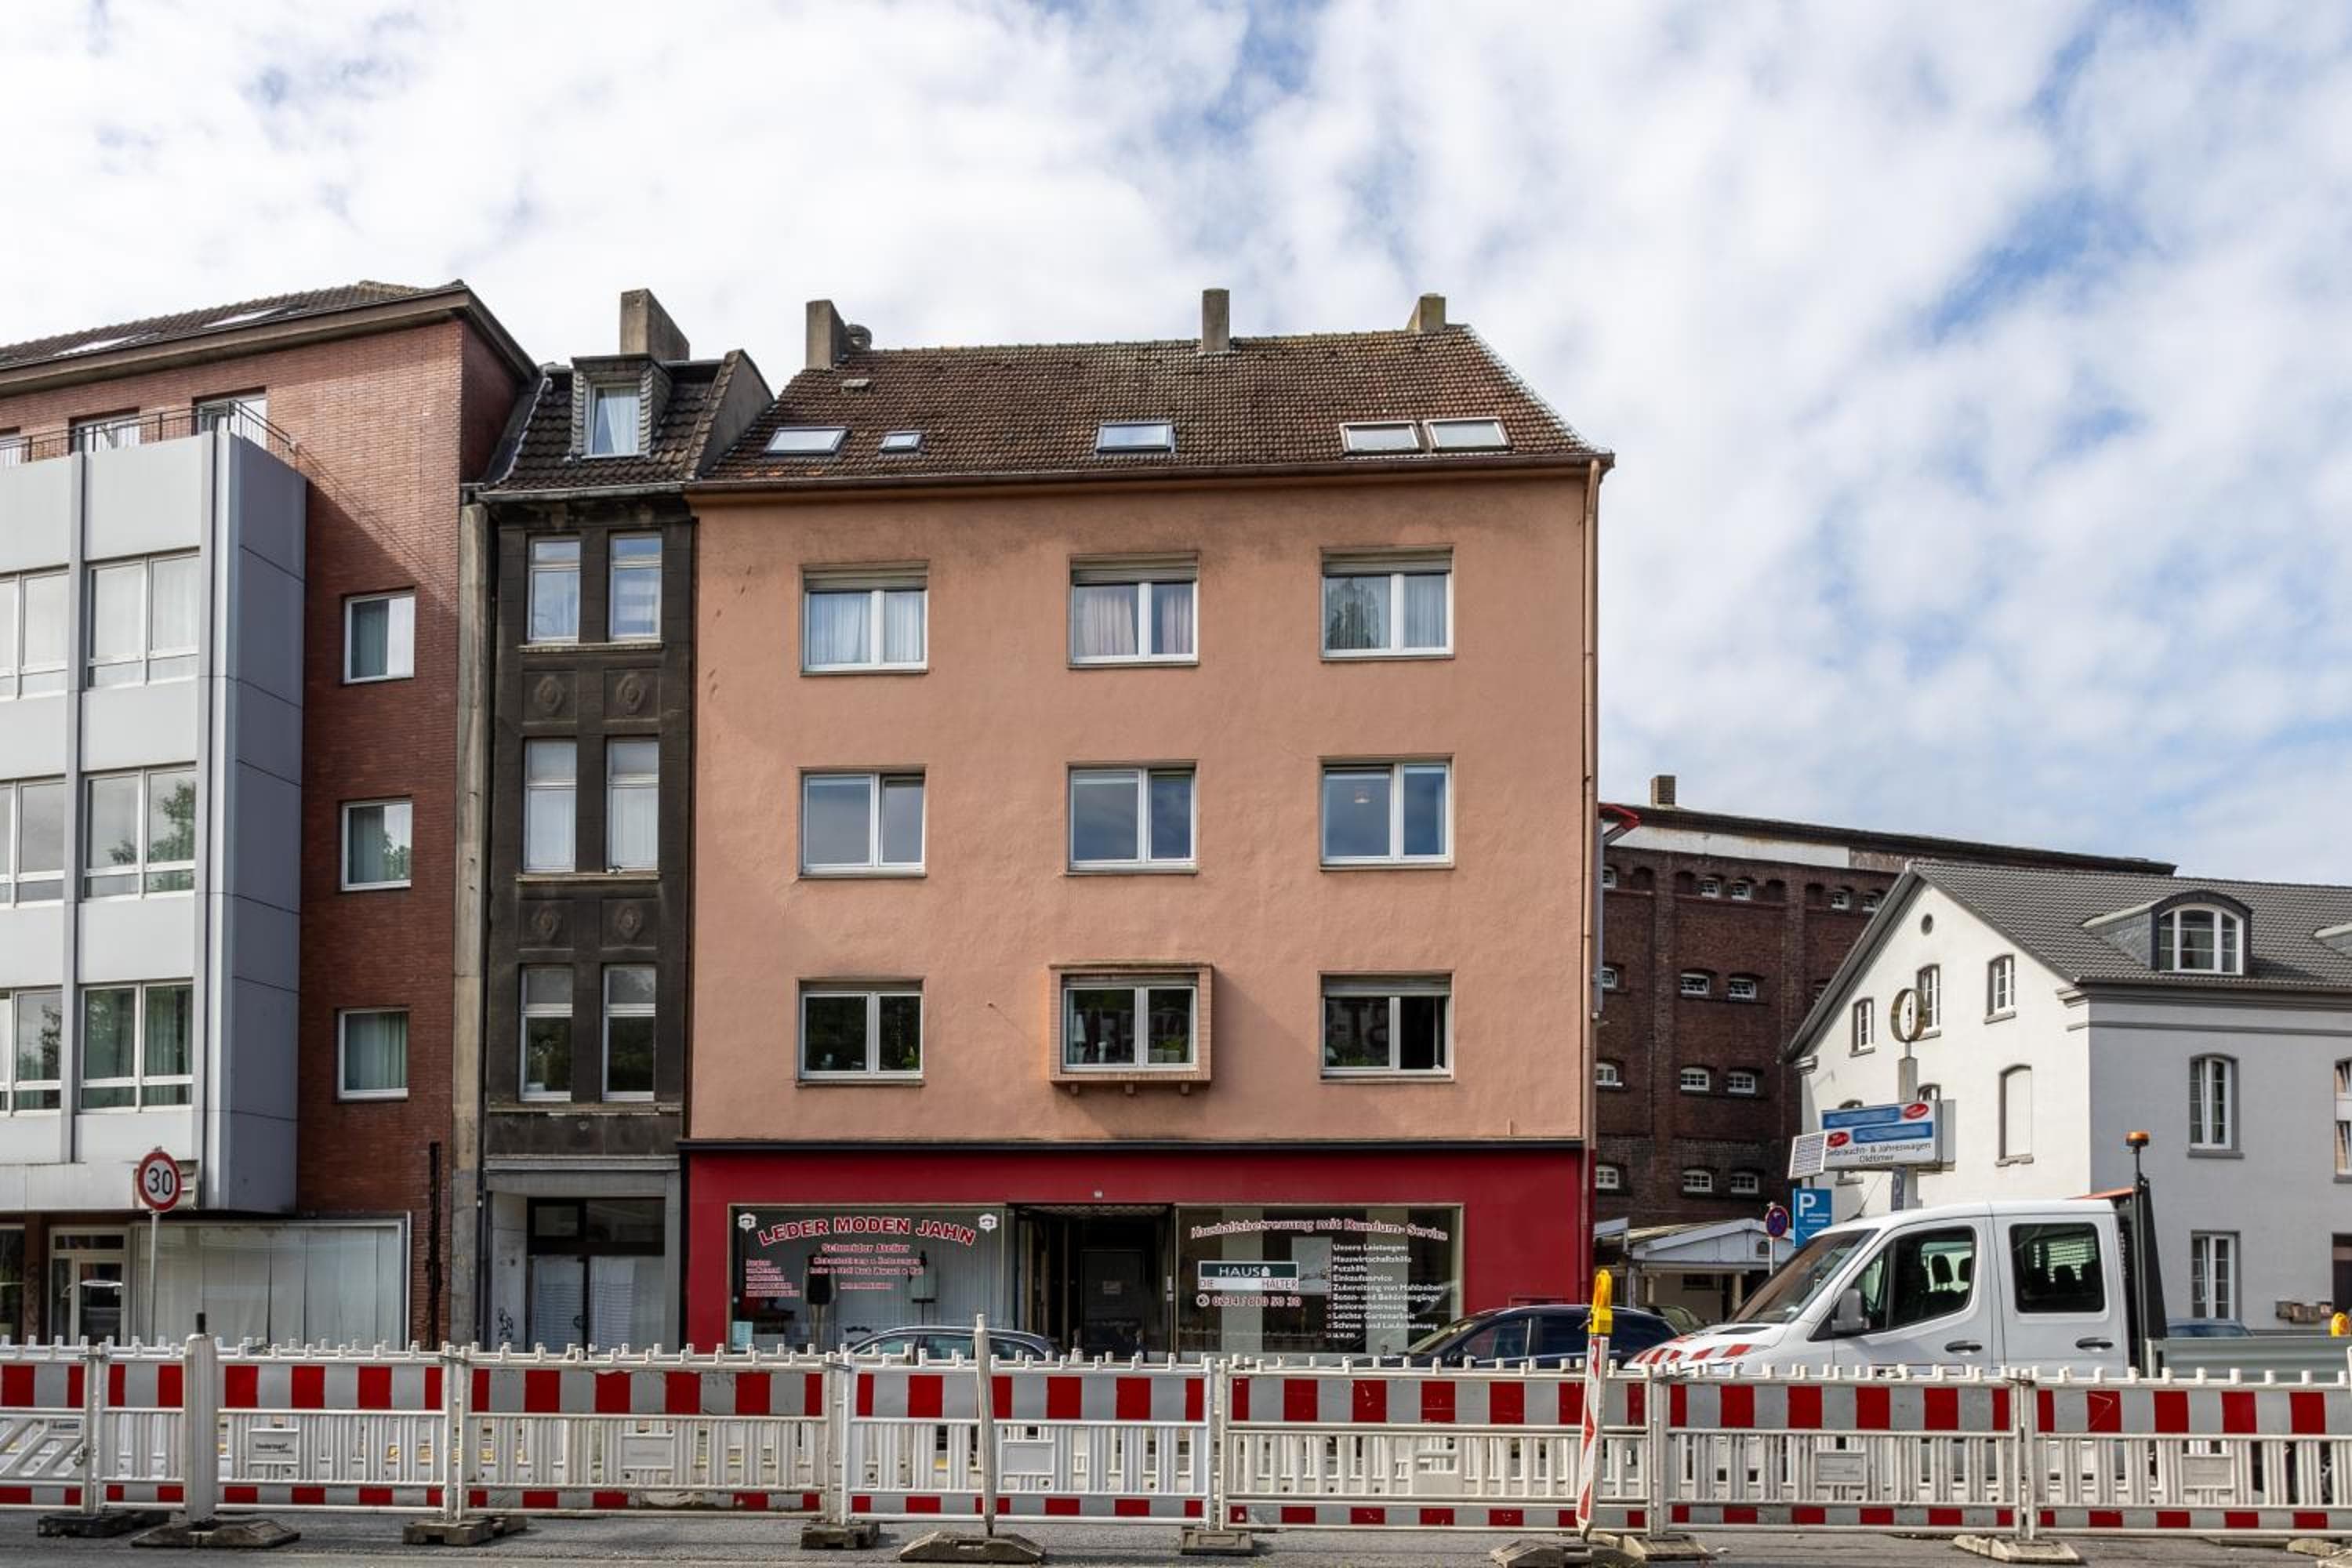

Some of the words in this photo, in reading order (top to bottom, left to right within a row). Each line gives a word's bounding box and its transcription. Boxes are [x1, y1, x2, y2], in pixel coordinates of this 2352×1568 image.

[148, 1167, 172, 1196] 30
[1798, 1192, 1817, 1218] P
[1316, 1218, 1342, 1230] mit
[757, 1218, 830, 1247] LEDER
[833, 1216, 911, 1236] MODEN
[915, 1219, 976, 1247] JAHN
[1333, 1243, 1362, 1252] Unsere
[1219, 1266, 1260, 1277] HAUS
[1200, 1279, 1214, 1288] DIE
